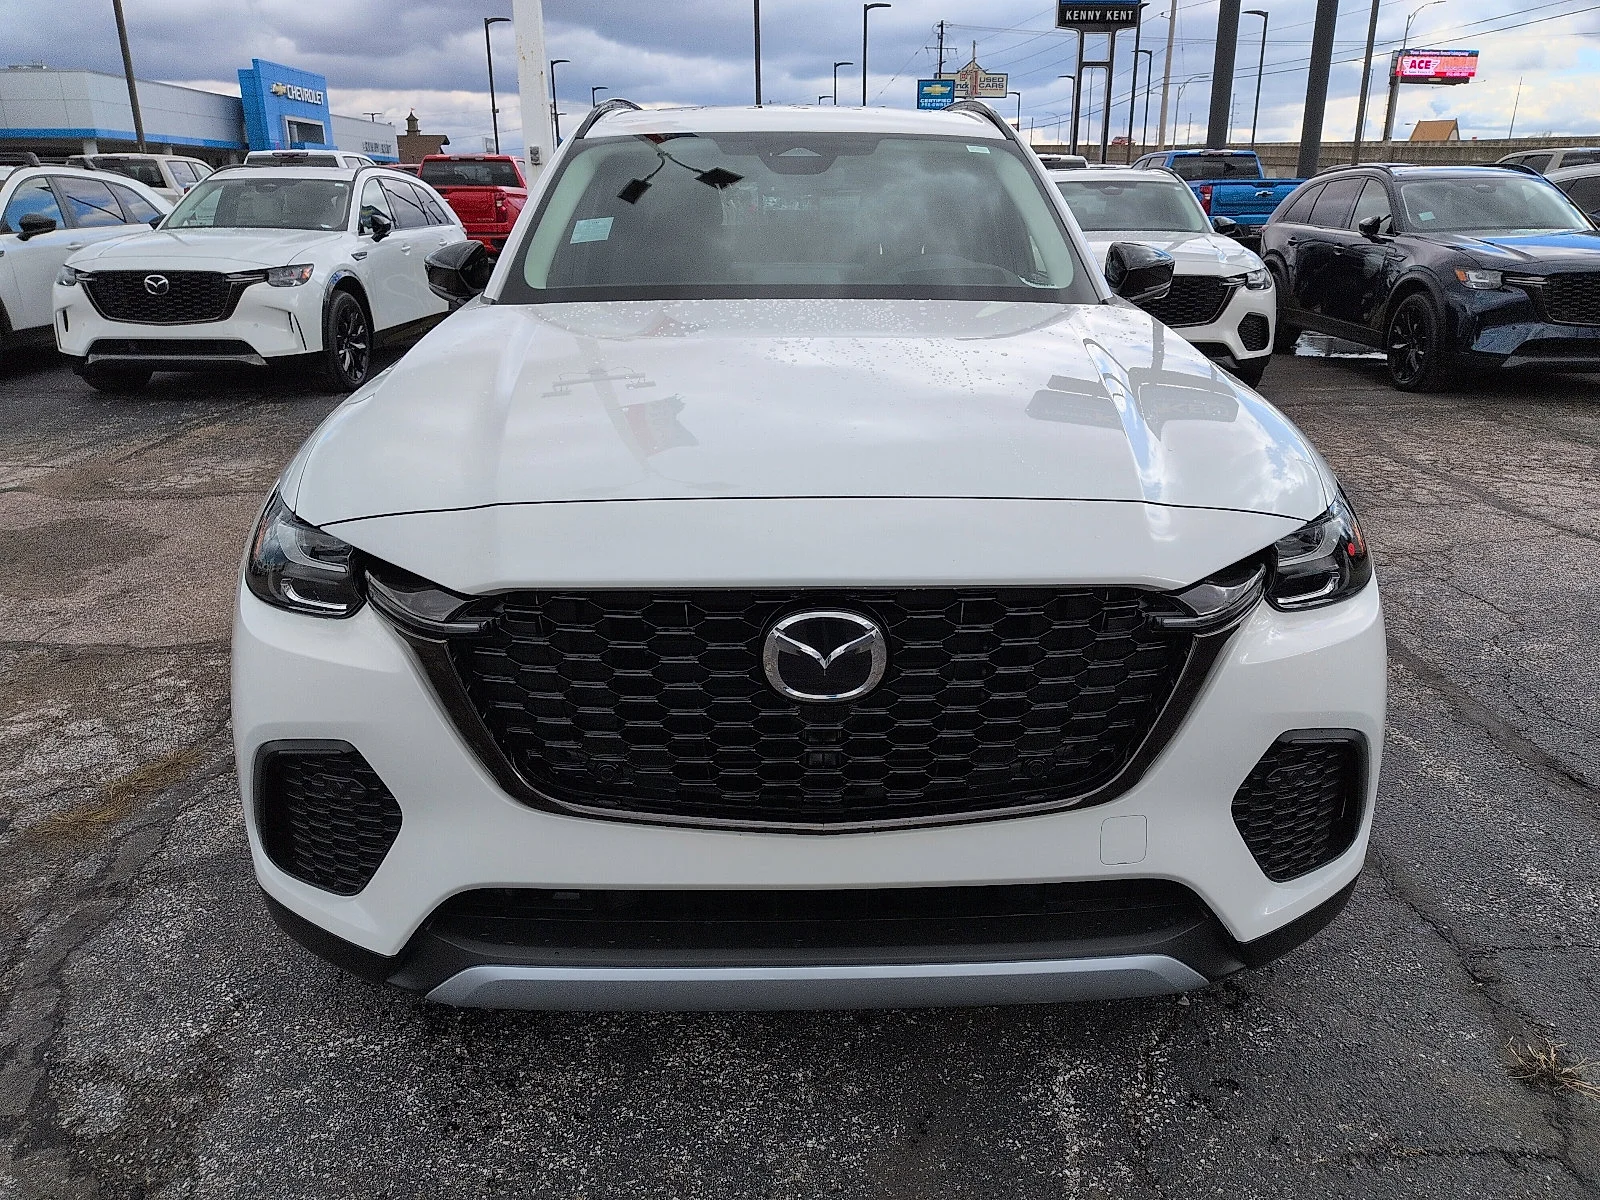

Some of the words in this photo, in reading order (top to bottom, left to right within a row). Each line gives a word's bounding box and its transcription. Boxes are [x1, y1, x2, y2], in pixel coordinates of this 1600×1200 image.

[1066, 10, 1101, 21] KENNY
[1106, 10, 1133, 21] KENT
[1409, 59, 1432, 70] ACE
[286, 84, 324, 106] CHEVROLET
